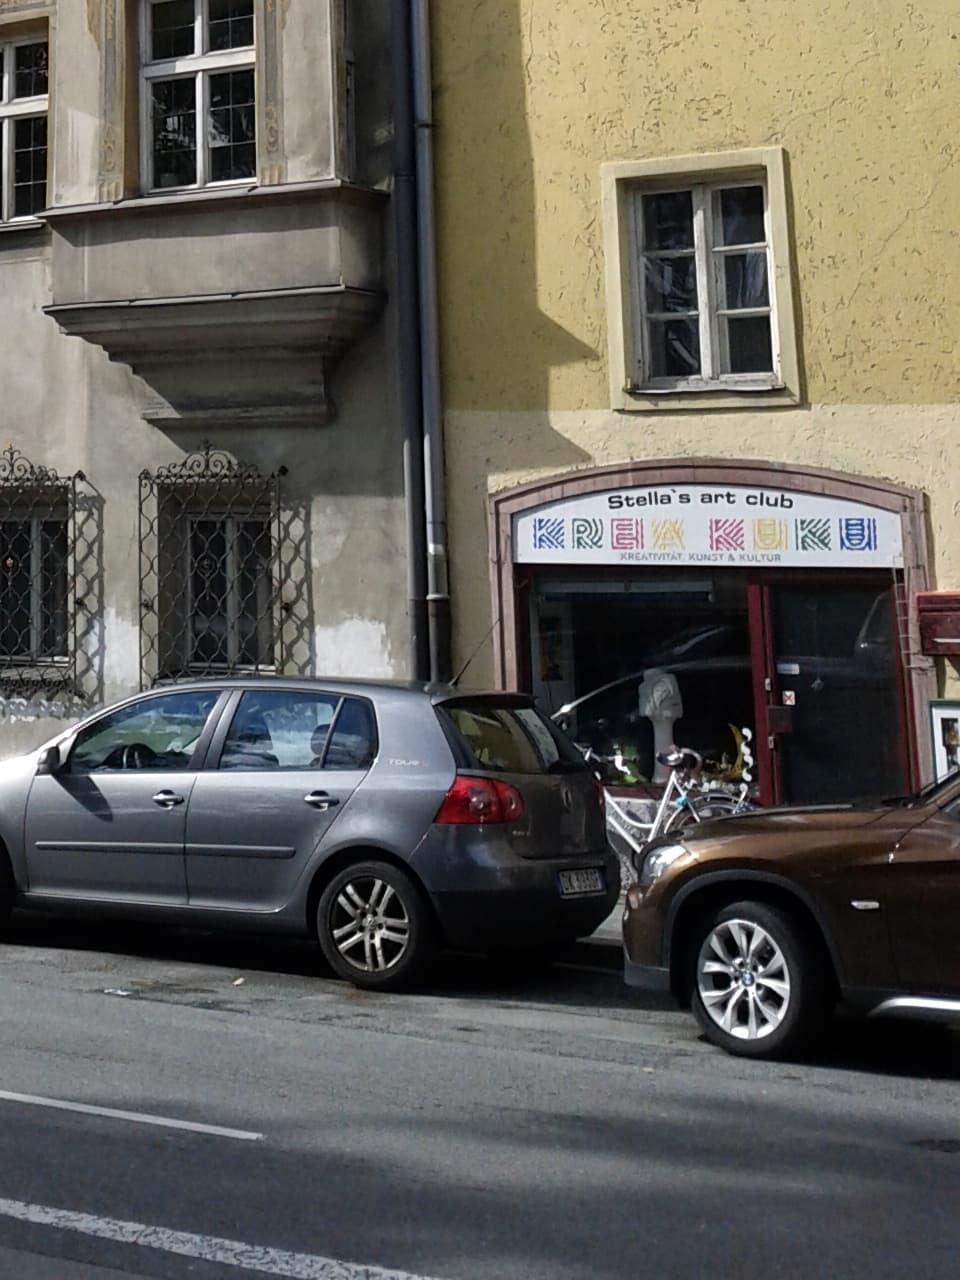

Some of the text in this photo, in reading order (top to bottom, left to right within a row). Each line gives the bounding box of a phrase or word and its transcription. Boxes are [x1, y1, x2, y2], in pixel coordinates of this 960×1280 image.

[700, 491, 737, 505] art
[745, 492, 794, 510] club
[533, 518, 878, 551] KREA KUKU
[689, 552, 724, 563] KUNST
[727, 553, 737, 563] &
[740, 552, 782, 564] KULTUR
